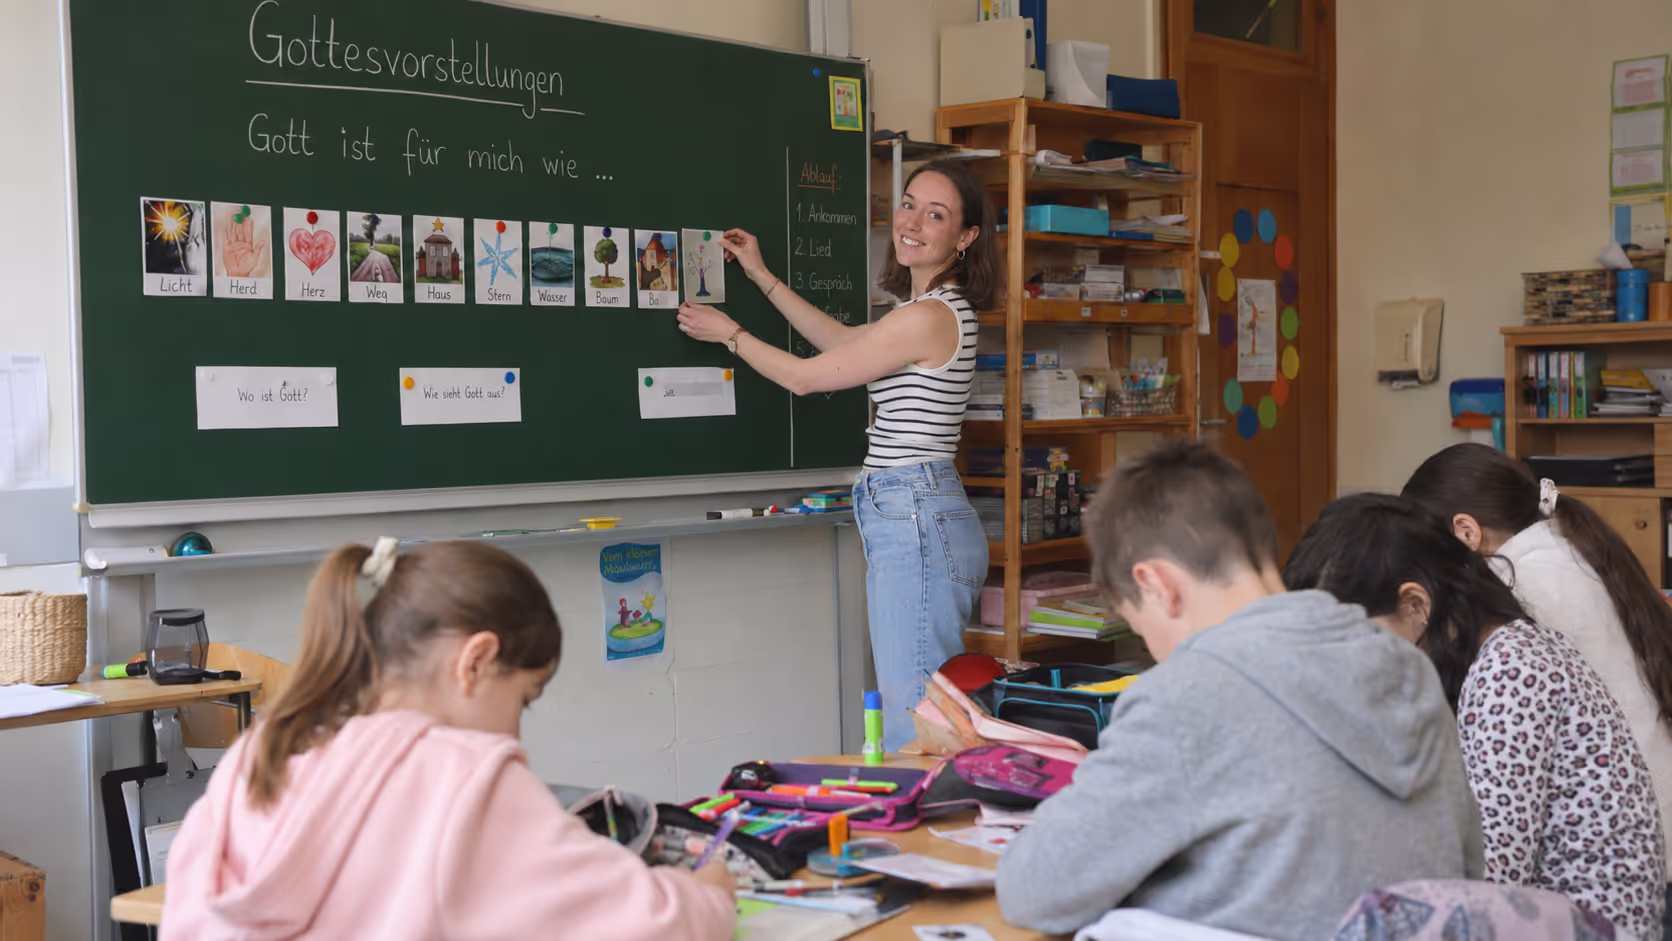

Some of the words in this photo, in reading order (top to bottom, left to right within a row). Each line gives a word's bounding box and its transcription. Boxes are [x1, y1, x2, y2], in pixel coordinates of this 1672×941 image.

[249, 0, 564, 119] Gottesvorstellungen
[248, 113, 314, 156] Gott
[341, 126, 376, 161] ist
[402, 128, 447, 176] für
[468, 139, 524, 173] mich
[543, 150, 578, 178] wie
[796, 202, 805, 223] 1.
[808, 204, 857, 225] Ankommen
[795, 236, 807, 256] 2.
[809, 237, 832, 257] Lied
[160, 277, 193, 293] Licht
[229, 279, 258, 295] Herd
[301, 282, 326, 298] Herz
[795, 272, 806, 290] 3.
[809, 272, 852, 297] Gespräch
[427, 286, 452, 300] Haus
[487, 287, 512, 301] Stern
[538, 289, 568, 303] Wasser
[596, 290, 619, 304] Baum
[237, 388, 254, 402] Wo
[261, 388, 273, 402] ist
[279, 386, 309, 402] Gott?
[423, 387, 439, 399] Wie
[442, 387, 461, 399] sieht
[464, 386, 484, 399] Gott
[487, 386, 505, 399] aus?
